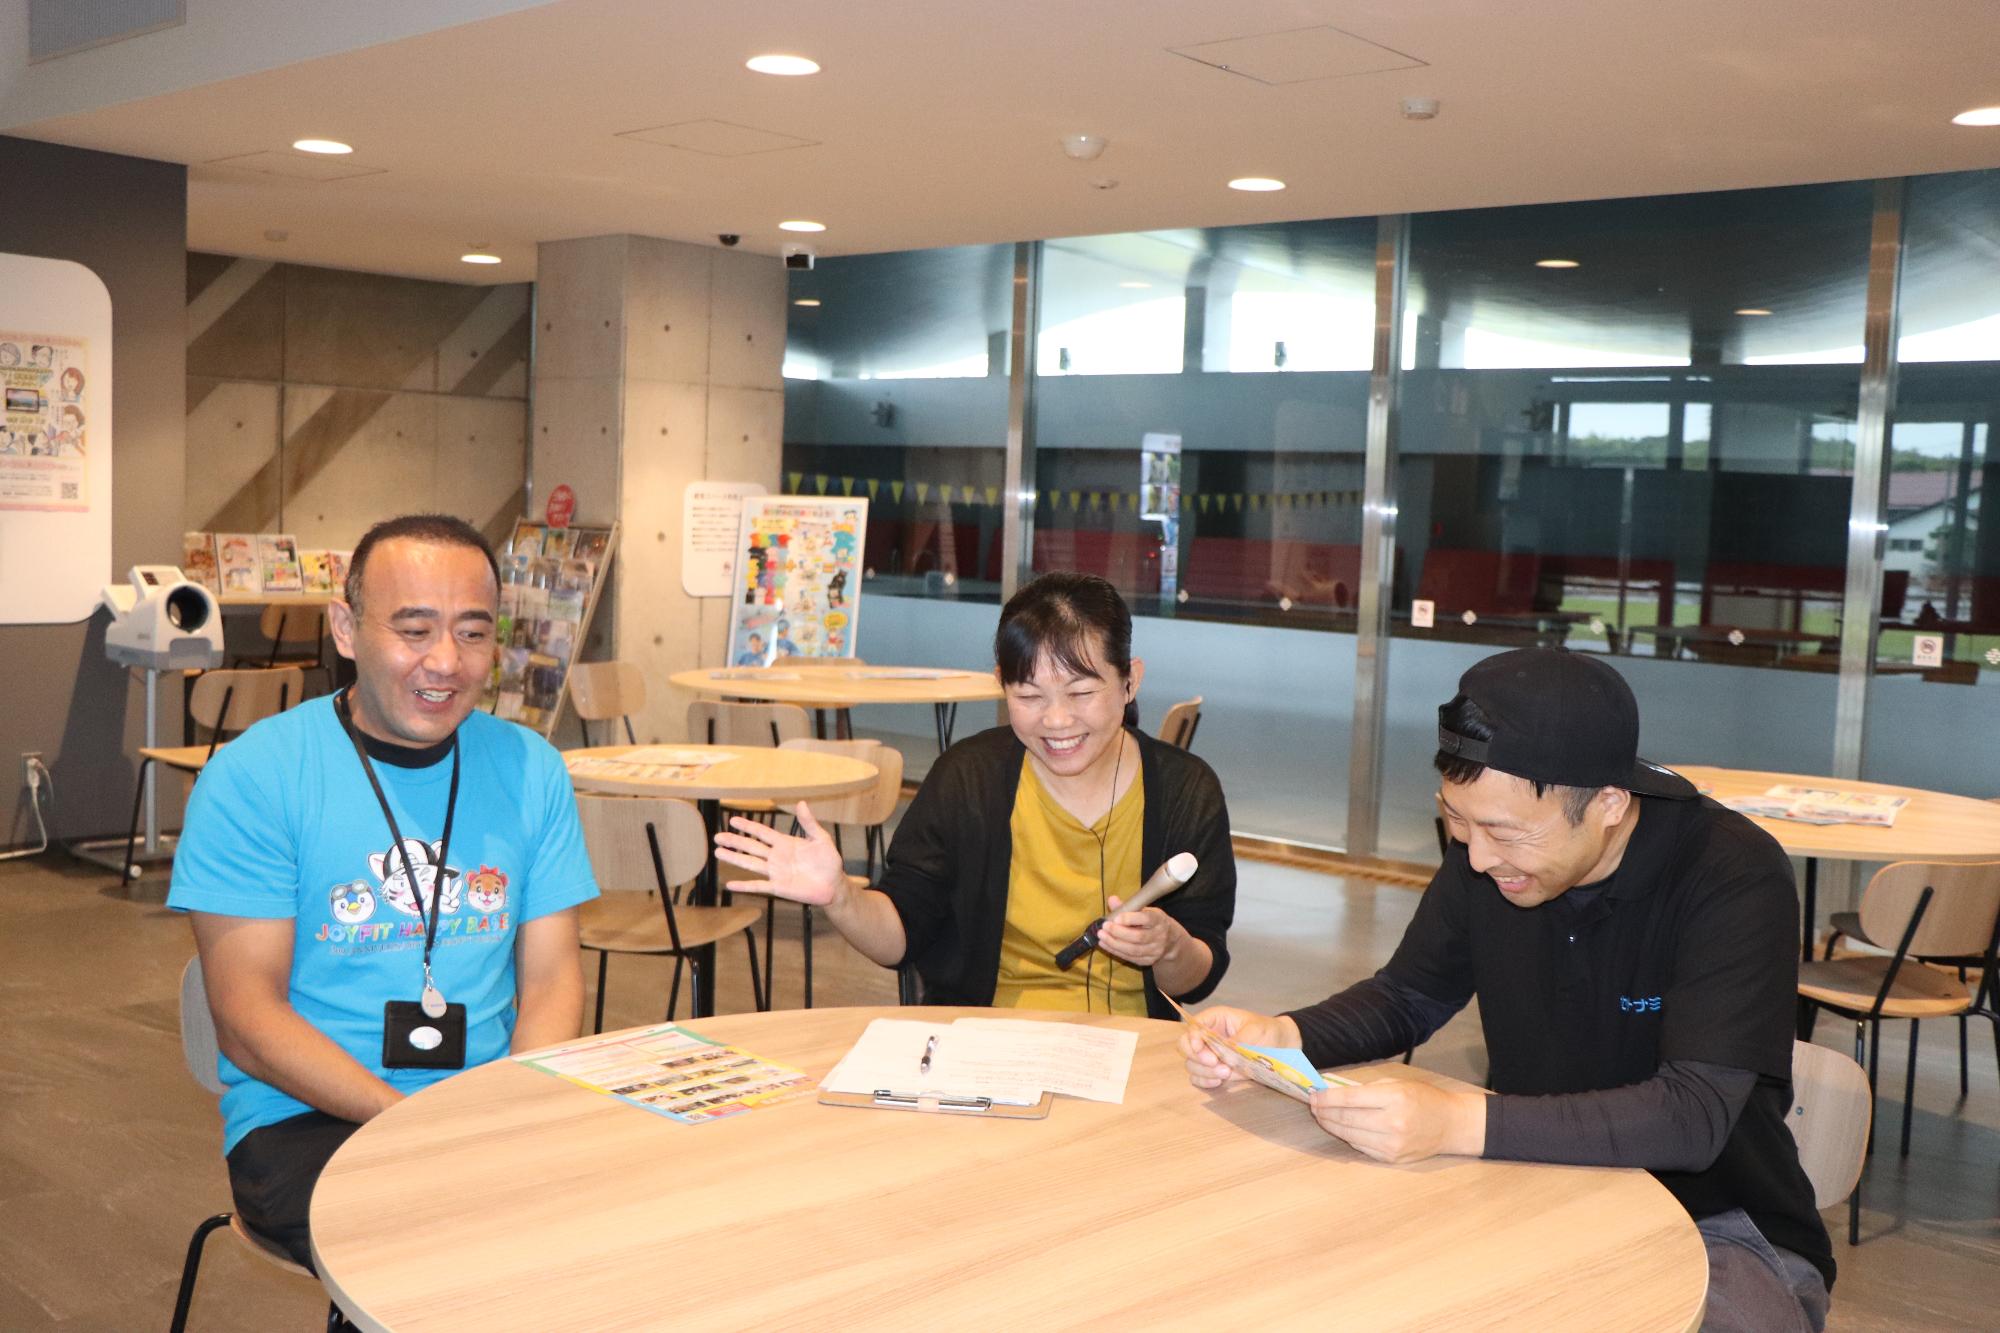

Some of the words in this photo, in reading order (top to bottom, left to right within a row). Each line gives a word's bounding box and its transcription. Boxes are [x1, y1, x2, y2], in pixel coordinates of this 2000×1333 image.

[315, 923, 393, 943] JOYFIT
[398, 918, 462, 938] HAPY
[466, 913, 509, 933] BASE
